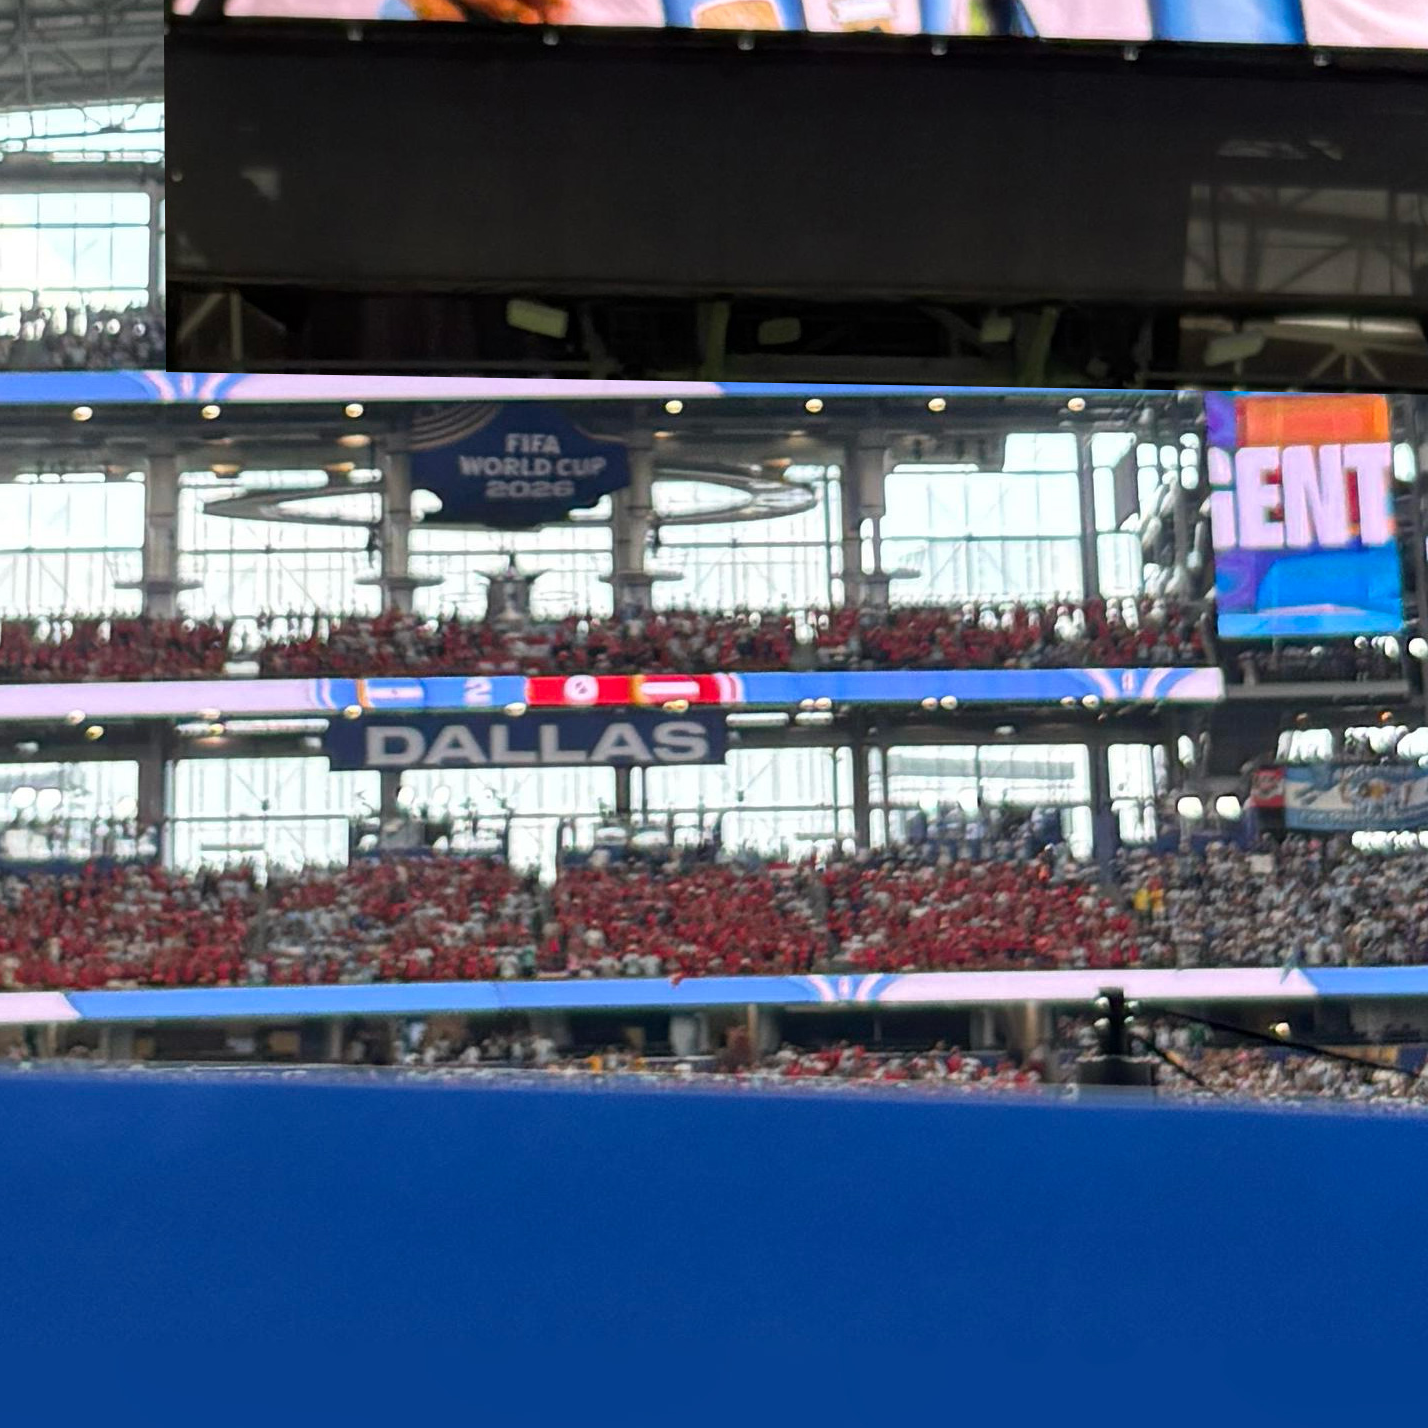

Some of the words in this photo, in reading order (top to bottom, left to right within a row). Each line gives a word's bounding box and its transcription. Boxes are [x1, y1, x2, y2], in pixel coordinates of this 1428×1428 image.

[504, 433, 561, 454] FIFA
[459, 455, 553, 476] WORLD
[556, 457, 607, 476] CUP
[485, 480, 575, 498] 2026
[464, 675, 492, 705] 2
[367, 721, 710, 766] DALLAS
